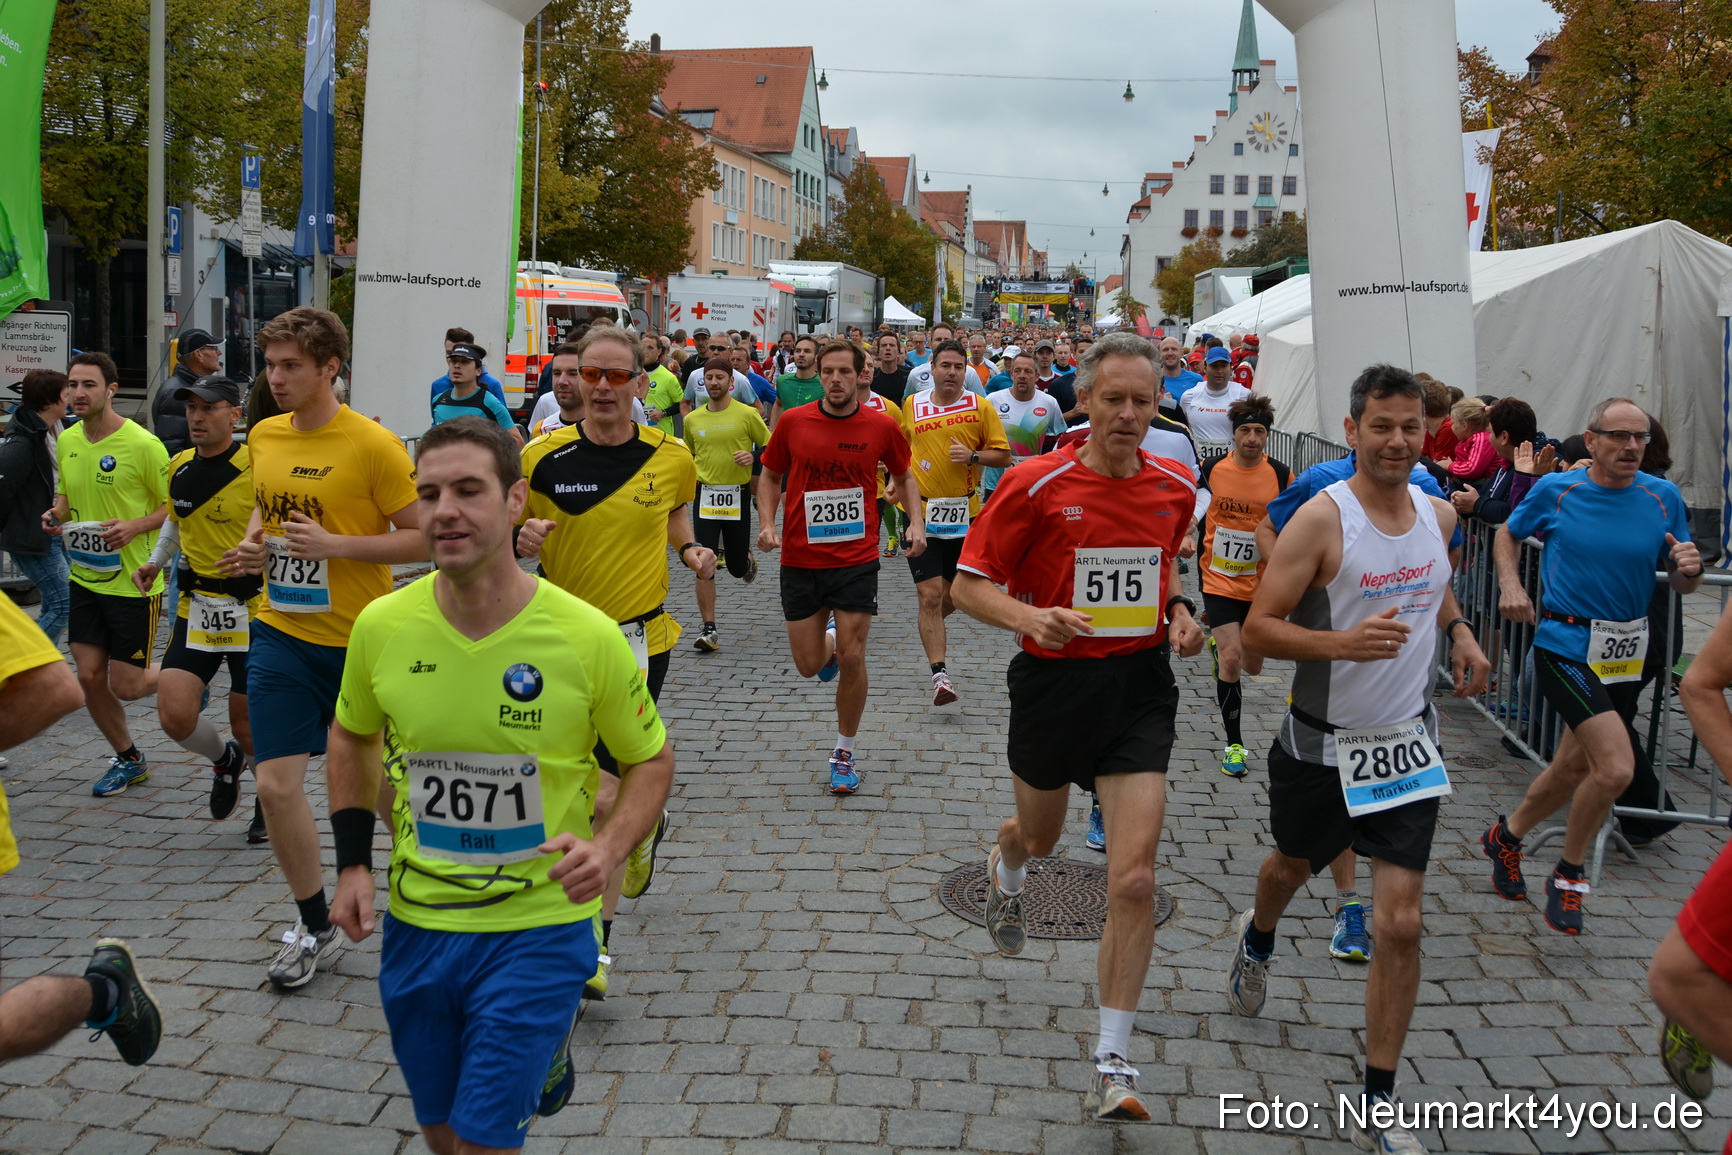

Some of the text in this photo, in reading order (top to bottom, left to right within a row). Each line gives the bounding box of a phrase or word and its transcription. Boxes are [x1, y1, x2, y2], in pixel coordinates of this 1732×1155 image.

[198, 269, 205, 285] 3
[358, 271, 482, 289] www.bmw-laufsport.de
[1338, 280, 1469, 297] www.bmw-laufsport.de
[34, 322, 67, 332] Richtung
[5, 332, 54, 341] Lammsbräu-
[2, 343, 37, 353] Kreuzung
[16, 355, 42, 363] Untere
[914, 415, 979, 435] MAX BÖGL
[96, 473, 114, 482] Partl
[555, 483, 598, 493] Markus
[709, 493, 733, 506] 100
[826, 493, 854, 501] Neumarkt
[812, 501, 859, 523] 2385
[931, 507, 966, 522] 2787
[1220, 501, 1252, 514] OEXL
[824, 527, 850, 535] Fabian
[1223, 540, 1254, 561] 175
[269, 553, 320, 584] 2732
[1103, 557, 1145, 565] Neumarkt
[1086, 570, 1142, 603] 515
[1362, 590, 1383, 599] Pure
[1384, 582, 1430, 596] Performance
[274, 588, 312, 603] Christian
[201, 609, 236, 631] 345
[1601, 636, 1640, 659] 365
[1601, 664, 1628, 675] Oswald
[500, 705, 542, 723] Partl
[499, 720, 541, 731] Neumarkt
[1338, 729, 1415, 746] PARTL Neumarkt
[409, 759, 515, 777] PARTL Neumarkt
[1350, 740, 1431, 782] 2800
[1372, 779, 1420, 800] Markus
[423, 775, 526, 823] 2671
[460, 833, 496, 849] Ralf
